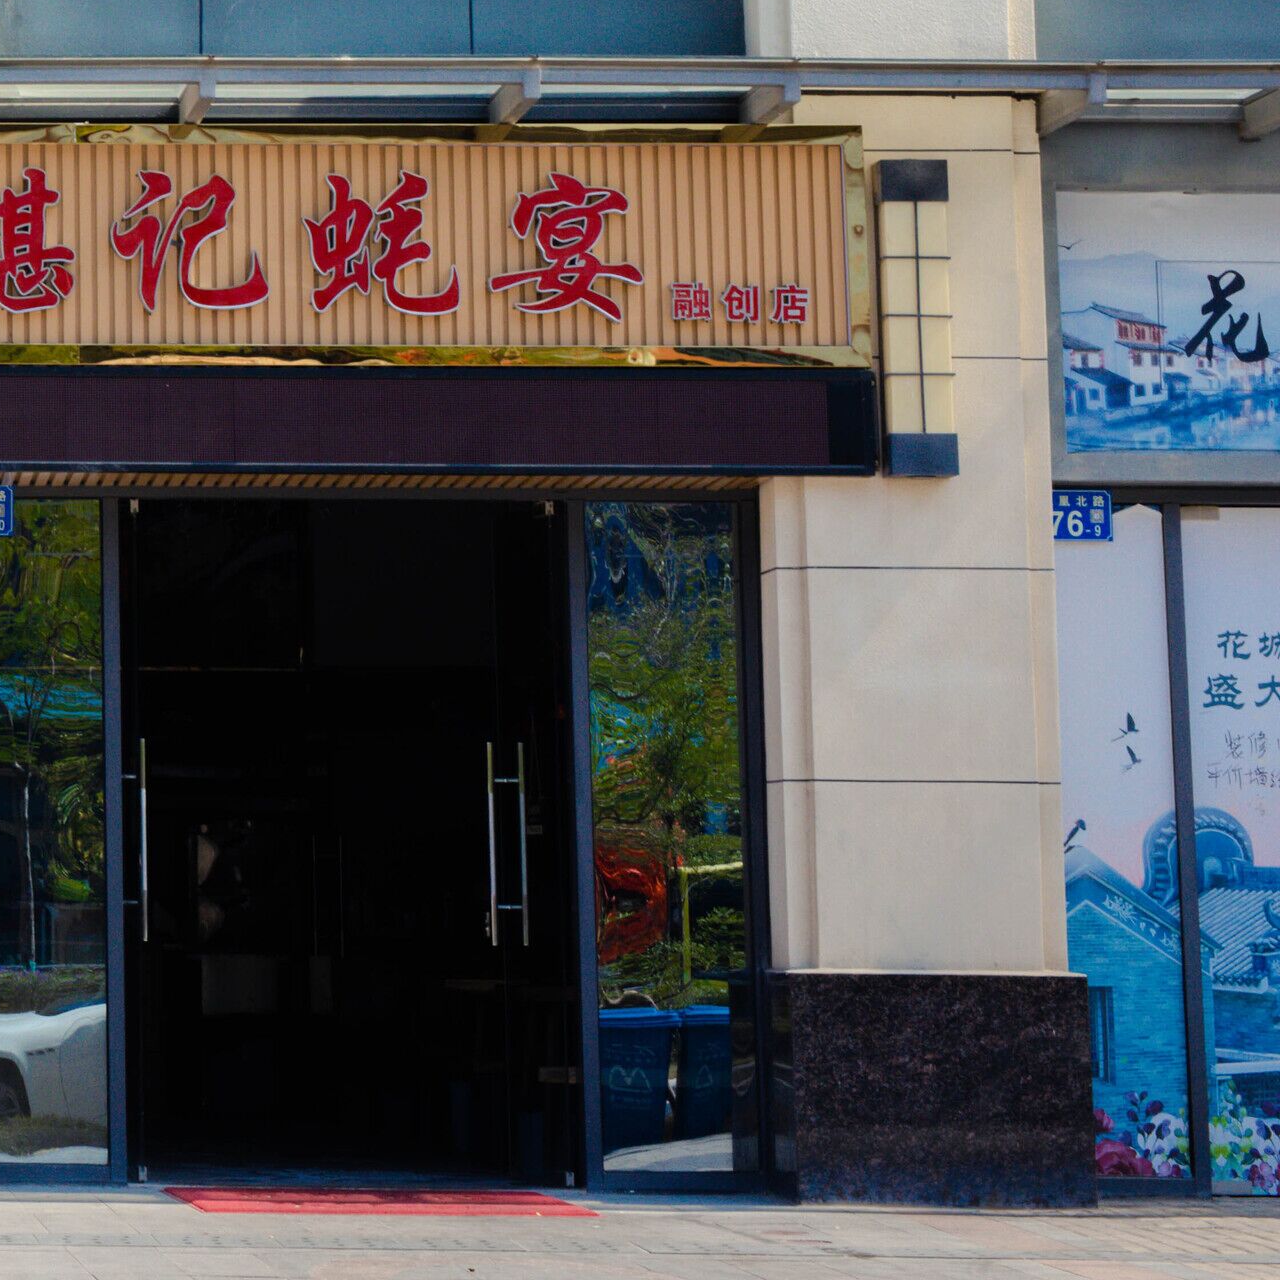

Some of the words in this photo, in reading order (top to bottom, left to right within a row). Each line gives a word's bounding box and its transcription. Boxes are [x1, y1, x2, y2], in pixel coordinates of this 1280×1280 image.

[671, 282, 810, 324] 融创店
[1058, 495, 1105, 507] 凰北路
[1225, 729, 1280, 760] 装修
